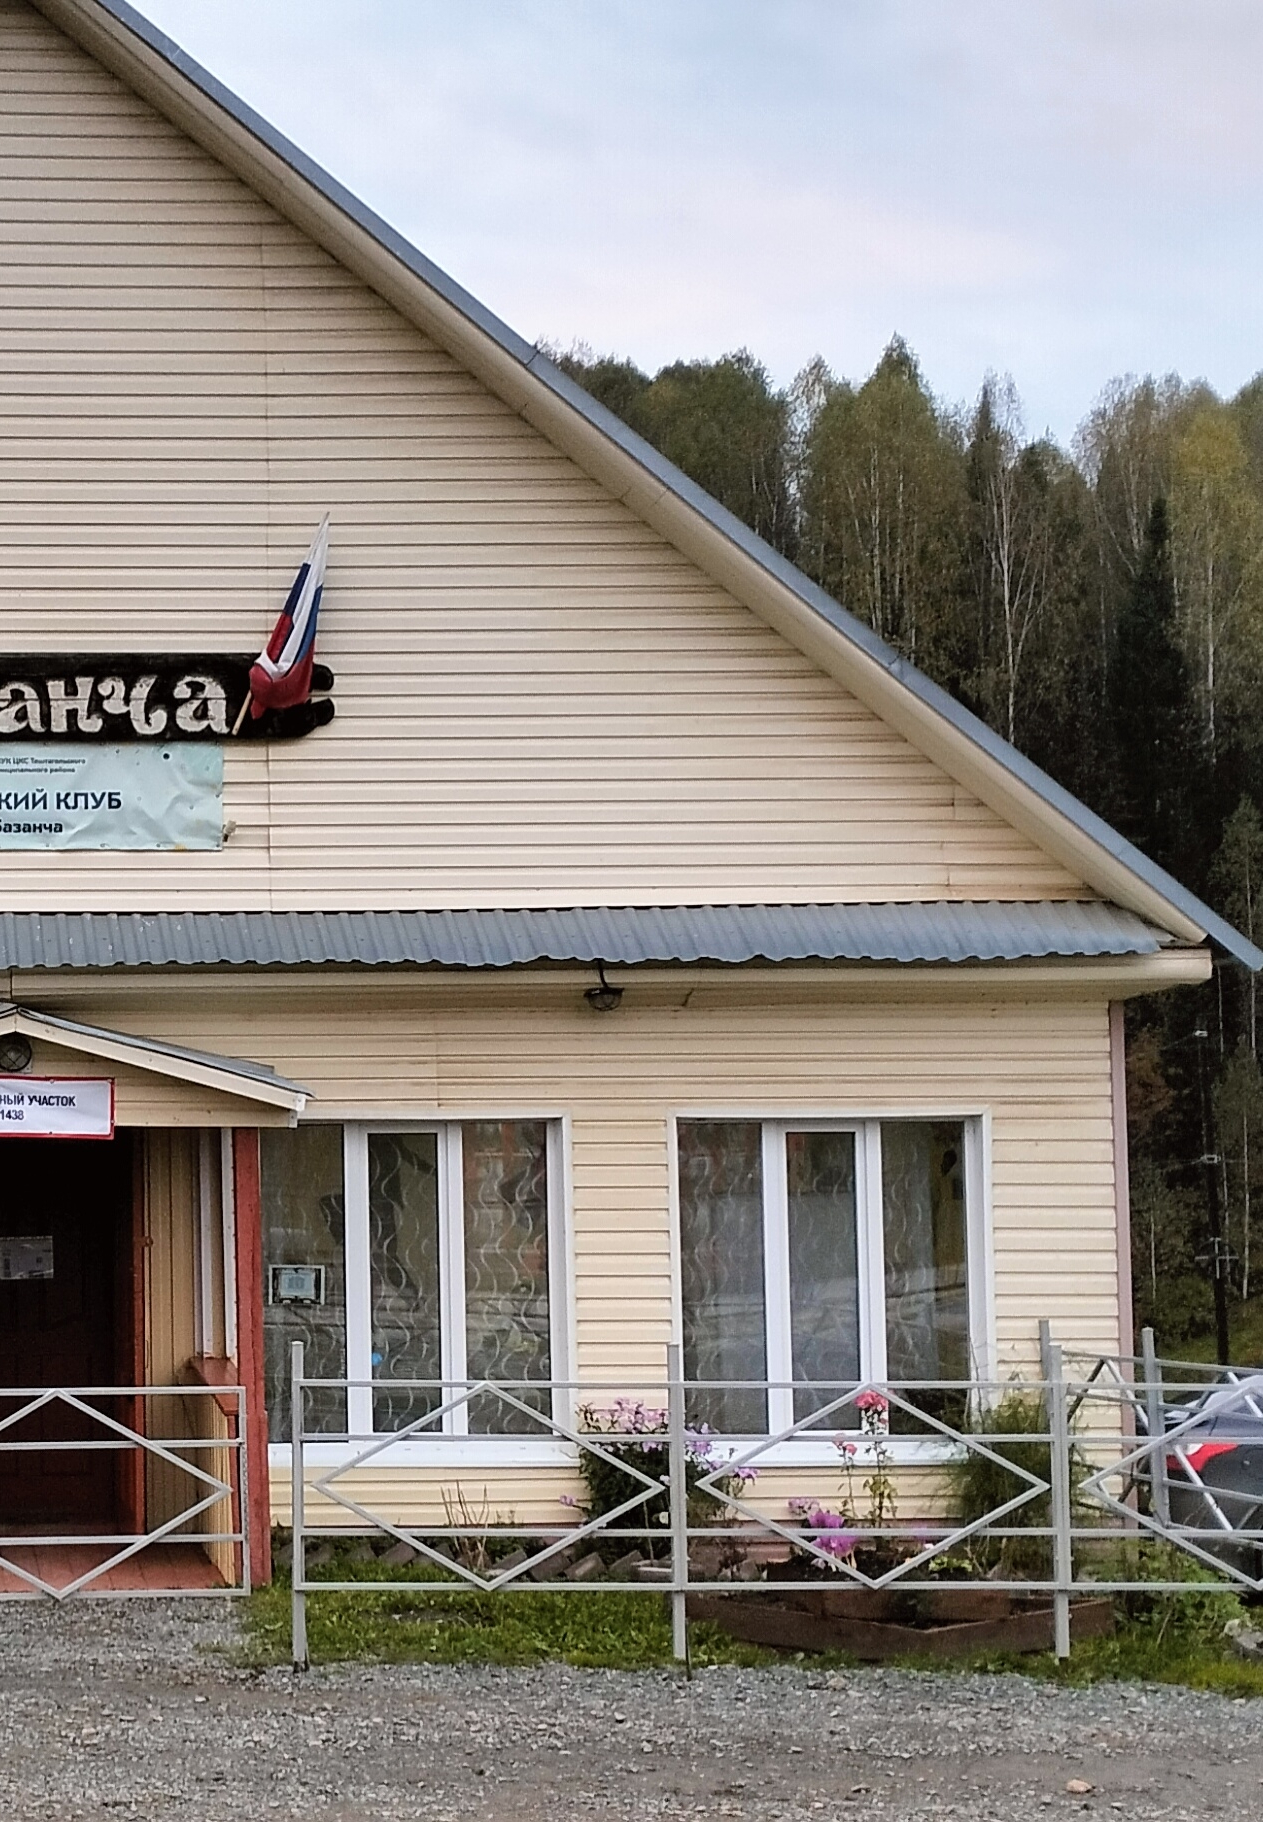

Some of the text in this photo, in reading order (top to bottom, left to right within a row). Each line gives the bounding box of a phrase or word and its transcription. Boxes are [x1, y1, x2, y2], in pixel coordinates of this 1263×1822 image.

[56, 791, 122, 810] КЛУБ
[27, 1095, 76, 1107] УЧАСТОК
[0, 1109, 25, 1120] 1438
